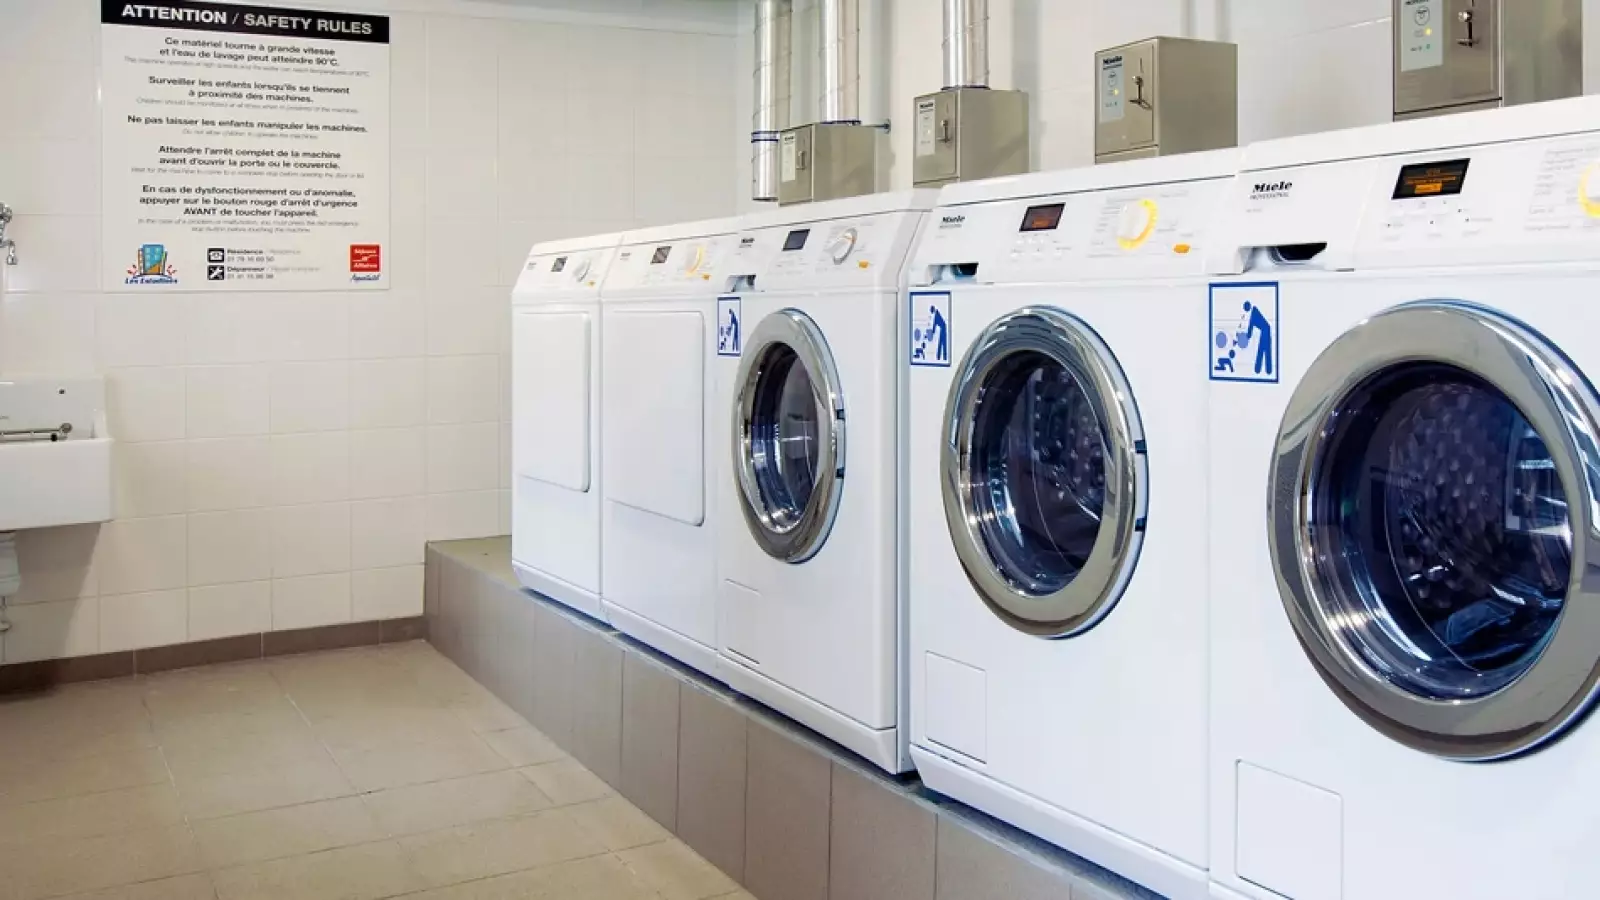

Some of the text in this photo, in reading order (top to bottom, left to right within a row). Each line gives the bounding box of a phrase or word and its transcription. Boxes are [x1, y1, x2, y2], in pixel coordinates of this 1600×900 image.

[121, 4, 371, 34] ATTENTION / SAFETY RULES
[181, 40, 221, 48] matériel
[224, 41, 256, 50] tourne
[267, 45, 300, 53] grande
[302, 47, 335, 55] vitesse
[159, 48, 169, 56] et
[171, 48, 195, 56] l'eau
[198, 50, 210, 58] de
[213, 50, 244, 60] lavage
[148, 75, 195, 85] Surveiller
[215, 80, 251, 88] enfants
[312, 85, 349, 94] tiennent
[245, 92, 263, 100] des
[166, 116, 198, 124] laisser
[201, 118, 215, 126] les
[158, 145, 202, 154] Attendre
[204, 147, 232, 155] l'arrêt
[235, 149, 274, 157] complet
[188, 157, 225, 165] d'ouvrir
[228, 158, 237, 166] la
[239, 159, 265, 167] porte
[142, 184, 155, 192] En
[194, 186, 286, 195] dysfonctionnement
[1252, 181, 1293, 193] Miele
[139, 197, 180, 205] appuyer
[213, 197, 247, 205] bouton
[250, 199, 278, 207] rouge
[280, 198, 310, 206] d'arrêt
[312, 199, 357, 208] d'urgence
[235, 208, 271, 216] toucher
